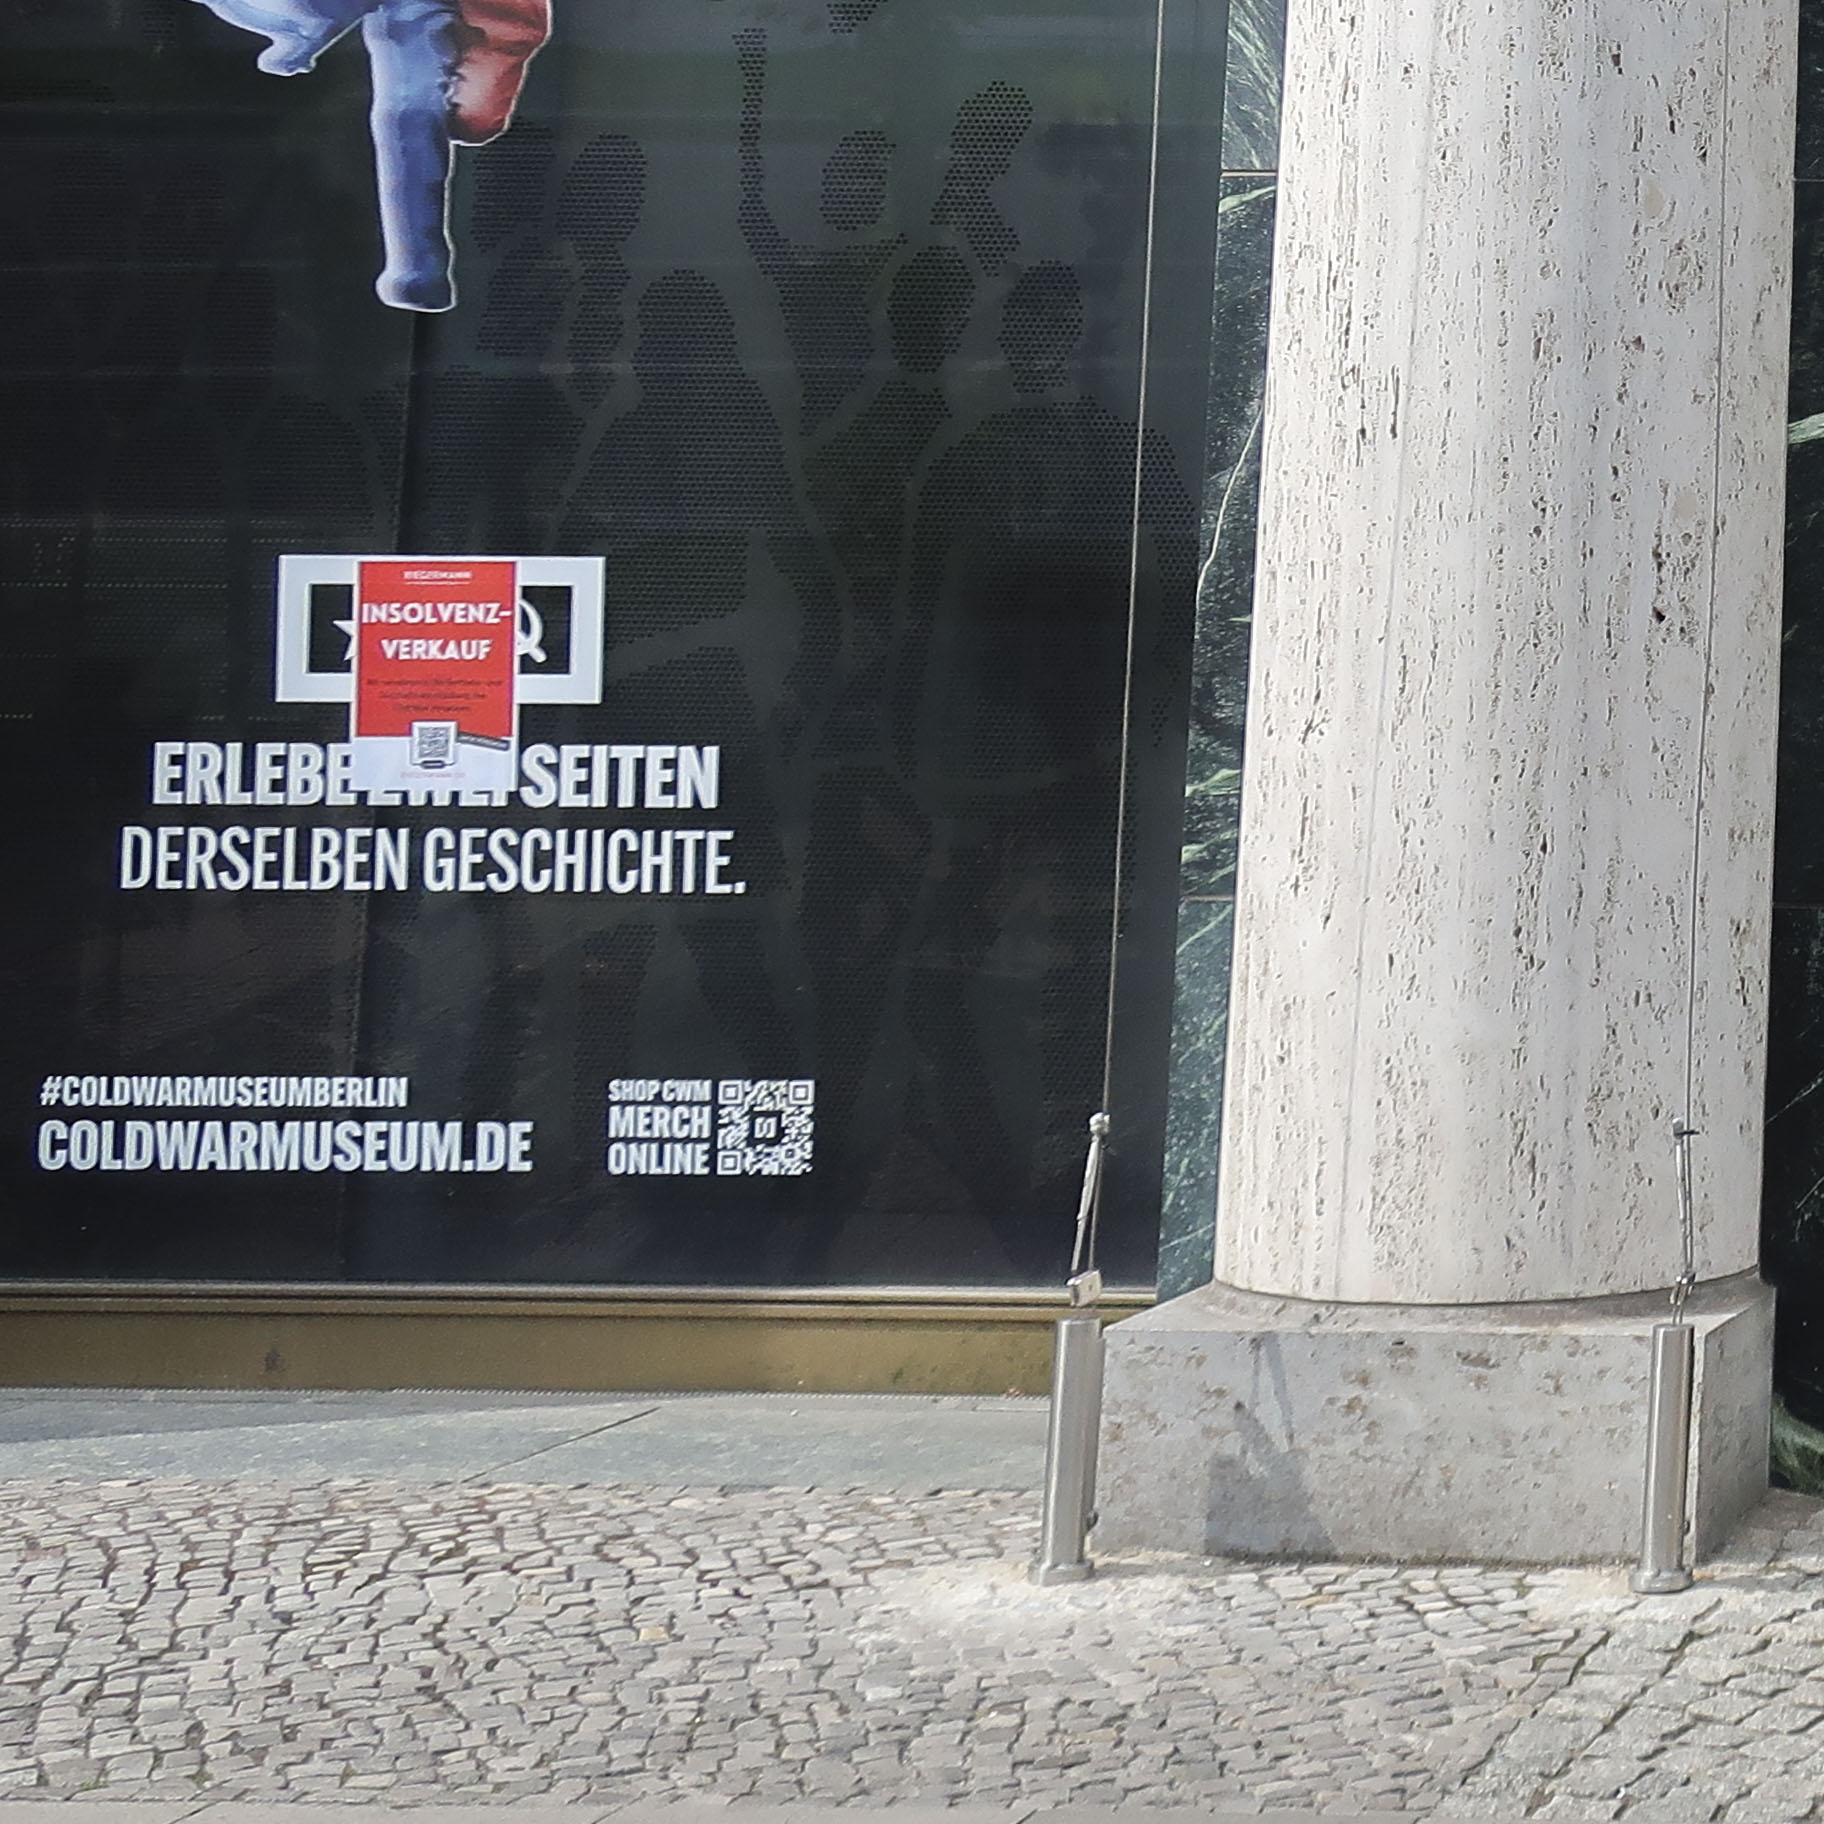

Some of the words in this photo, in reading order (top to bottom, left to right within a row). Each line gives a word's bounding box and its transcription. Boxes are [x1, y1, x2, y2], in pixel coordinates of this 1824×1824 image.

[362, 601, 513, 624] INSOLVENZ-
[381, 638, 493, 661] VERKAUF
[519, 743, 720, 809] SEITEN
[120, 825, 410, 891] DERSELBEN
[423, 827, 746, 894] GESCHICHTE.
[40, 1075, 408, 1108] #COLDWARMUSEUMBERLIN
[608, 1078, 659, 1102] SHOP
[661, 1078, 712, 1102] CWM
[608, 1105, 712, 1138] MERCH
[38, 1119, 534, 1173] COLDWARMUSEUM.DE
[607, 1141, 711, 1175] ONLINE
